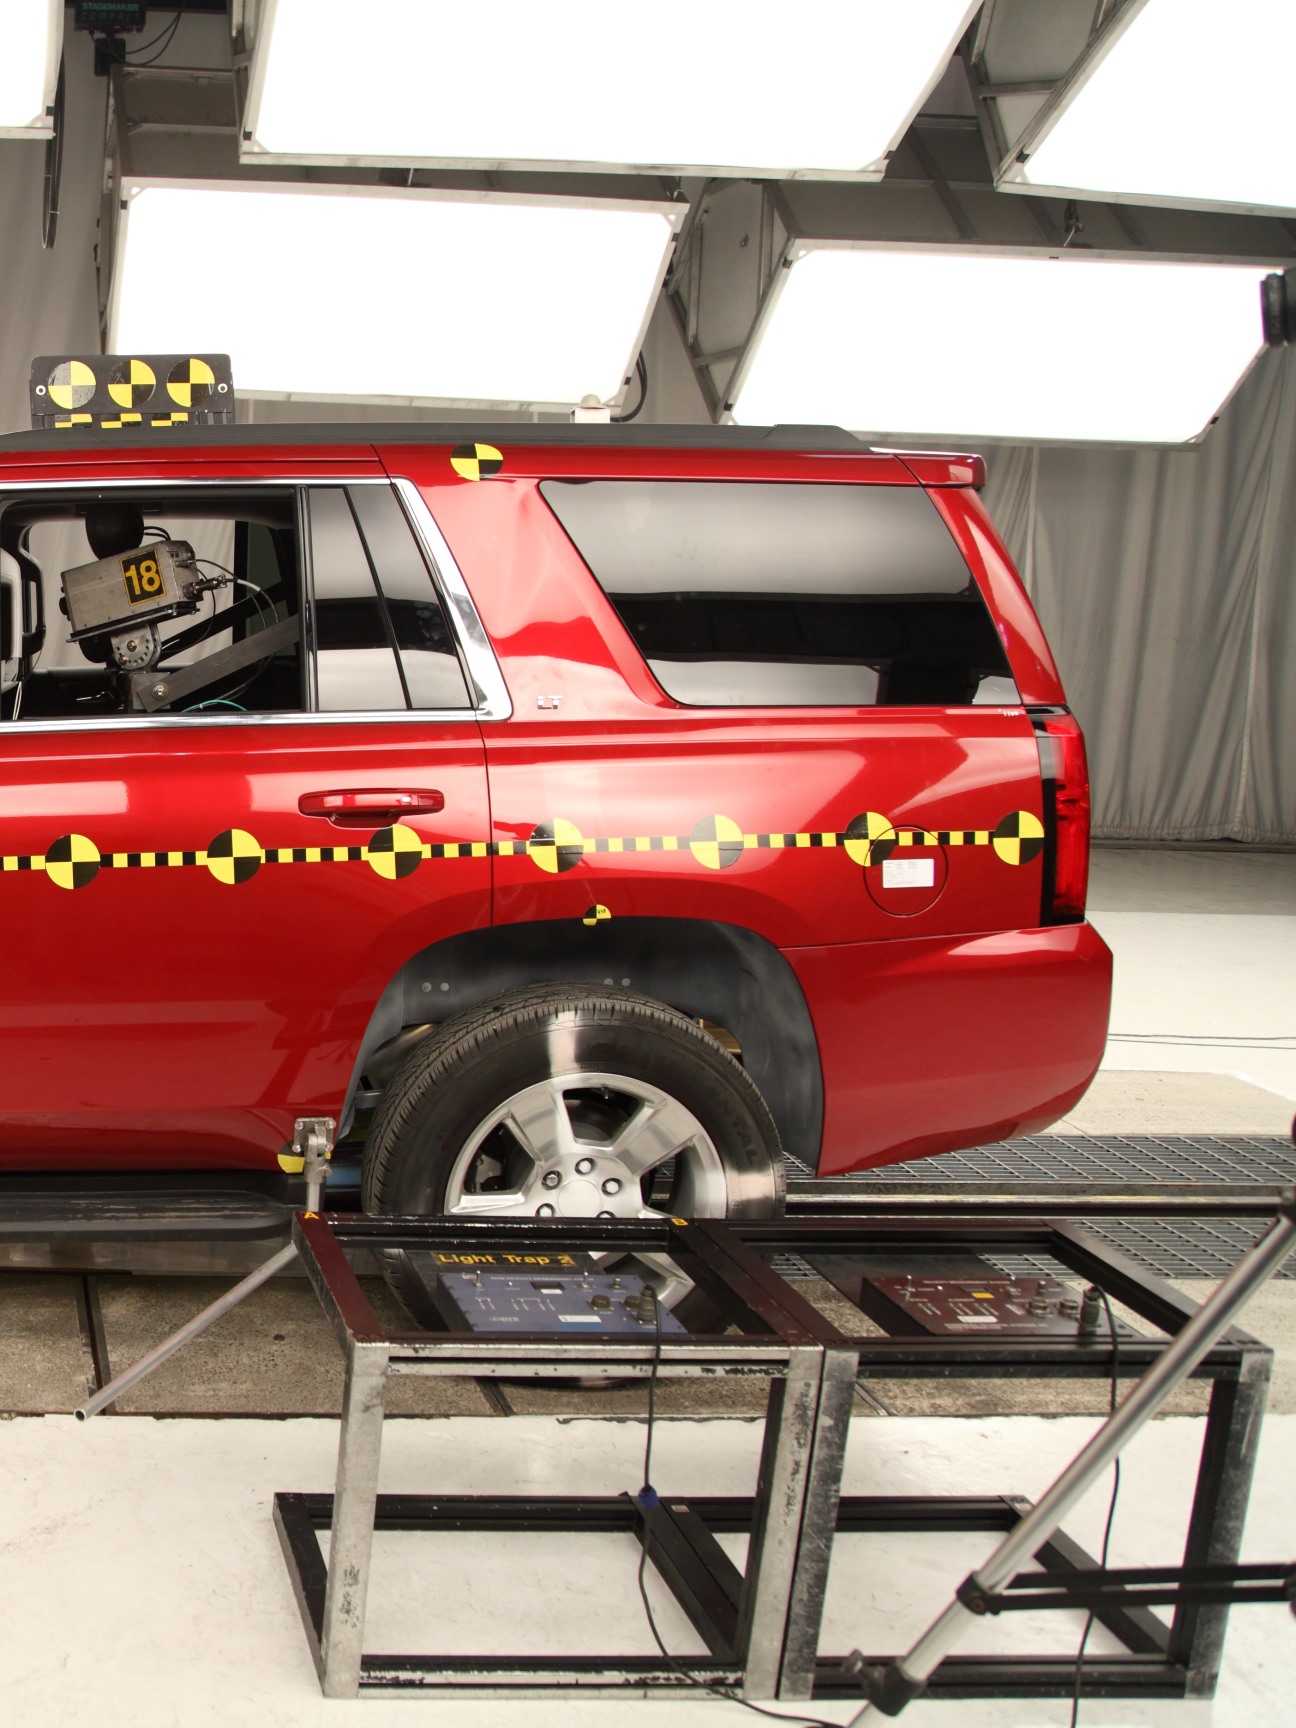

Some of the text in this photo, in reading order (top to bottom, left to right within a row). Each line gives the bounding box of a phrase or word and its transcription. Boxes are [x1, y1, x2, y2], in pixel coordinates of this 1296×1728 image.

[82, 2, 139, 11] STAGEMAKER
[125, 560, 161, 596] 18
[304, 1211, 320, 1219] A
[671, 1218, 689, 1226] B
[438, 1253, 496, 1265] Light
[502, 1254, 551, 1266] Trap
